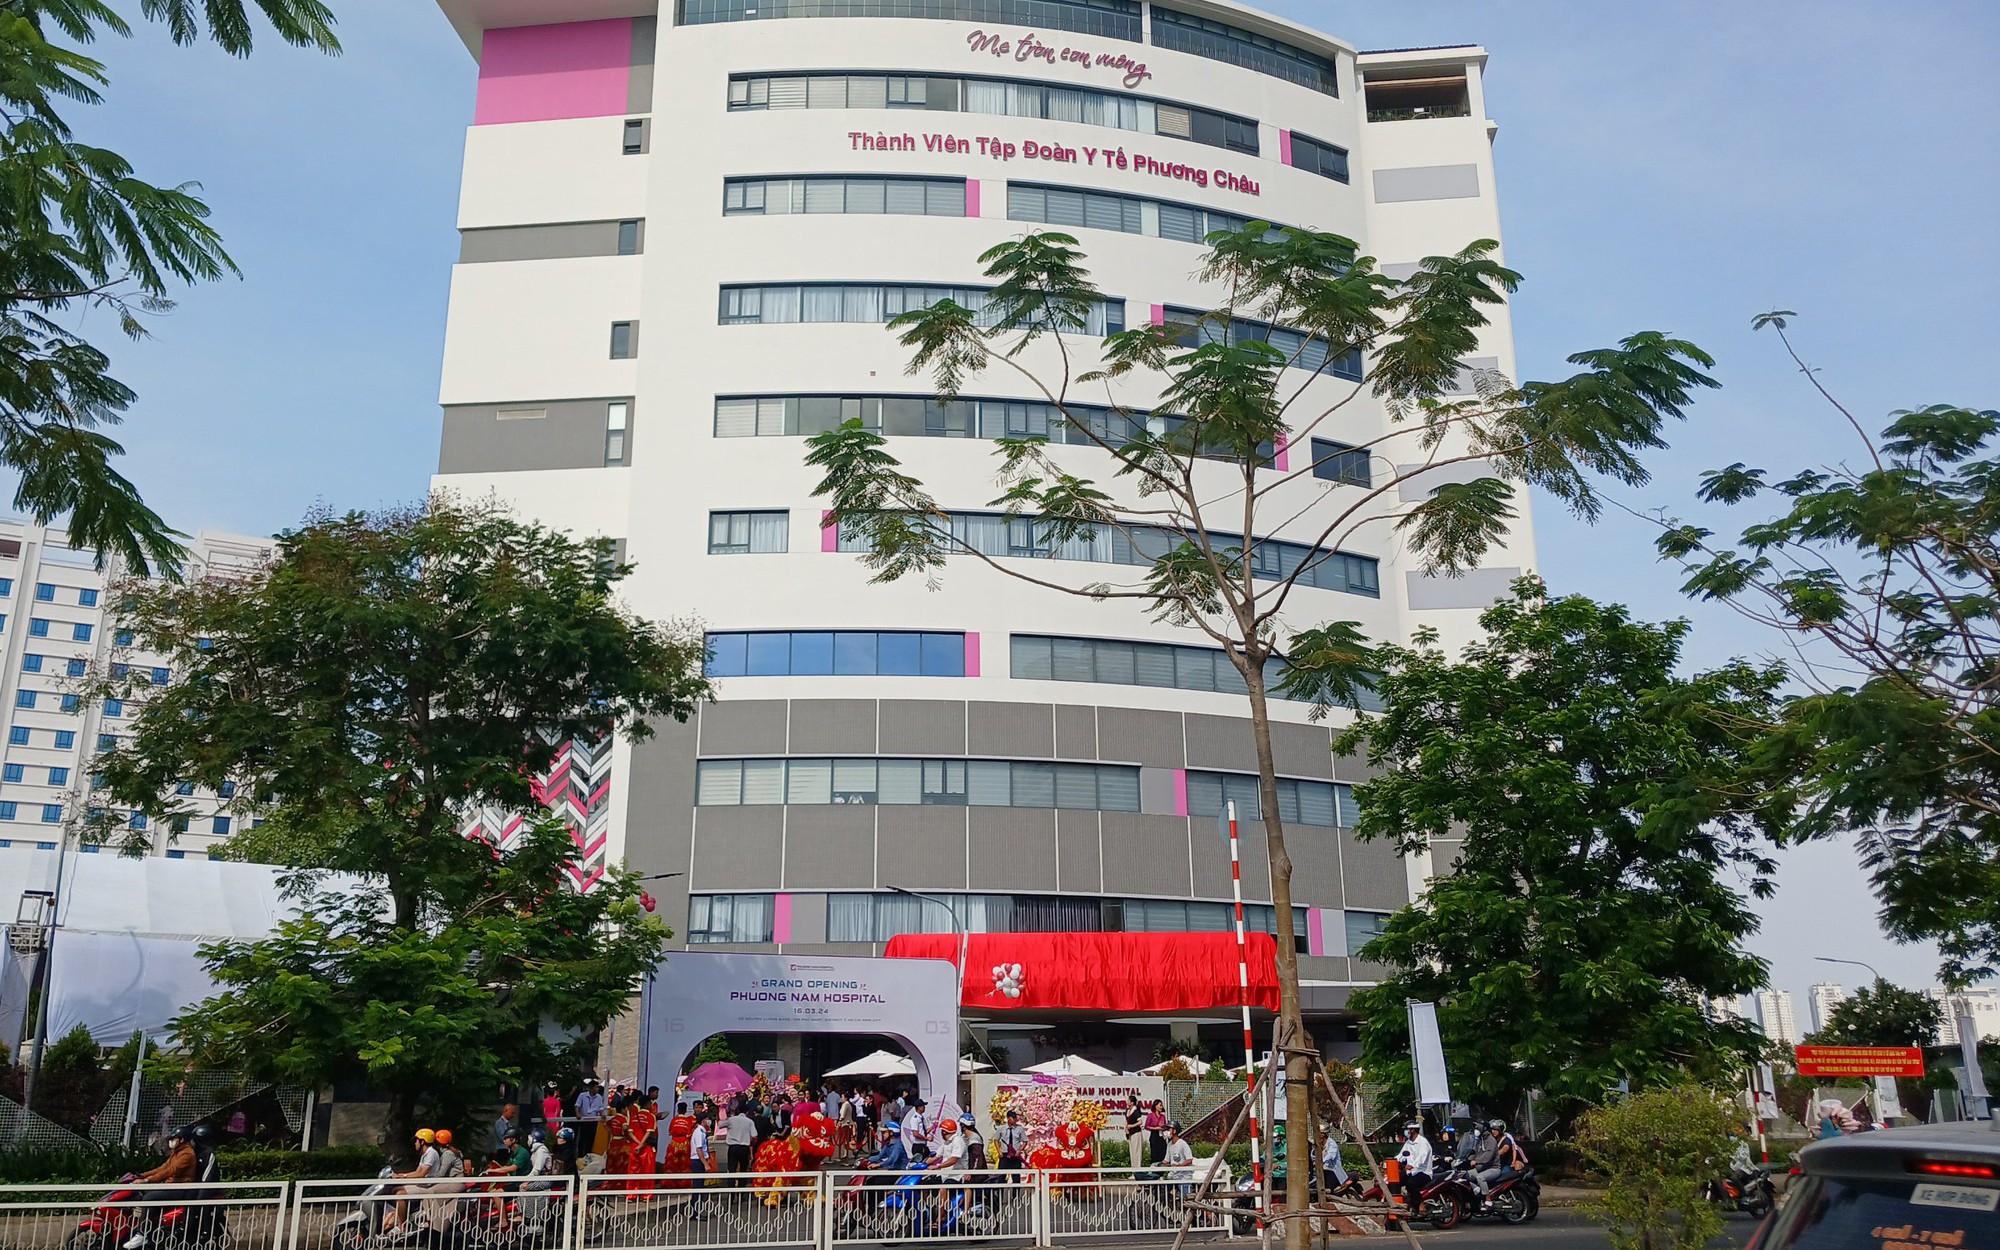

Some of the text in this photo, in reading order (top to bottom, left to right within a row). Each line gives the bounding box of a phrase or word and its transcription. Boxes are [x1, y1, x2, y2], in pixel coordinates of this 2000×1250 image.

[967, 30, 1152, 88] Mẹ tròn con vuông
[848, 131, 1260, 196] Thành Viên Tập Đoàn Y Tế Phương Châu
[761, 979, 858, 990] GRAND OPENING
[730, 992, 886, 1004] PHUONG NAM HOSPITAL
[663, 1018, 685, 1032] 16
[926, 1021, 950, 1034] 03
[1076, 1087, 1095, 1096] NAM
[1098, 1087, 1142, 1096] HOSPITAL
